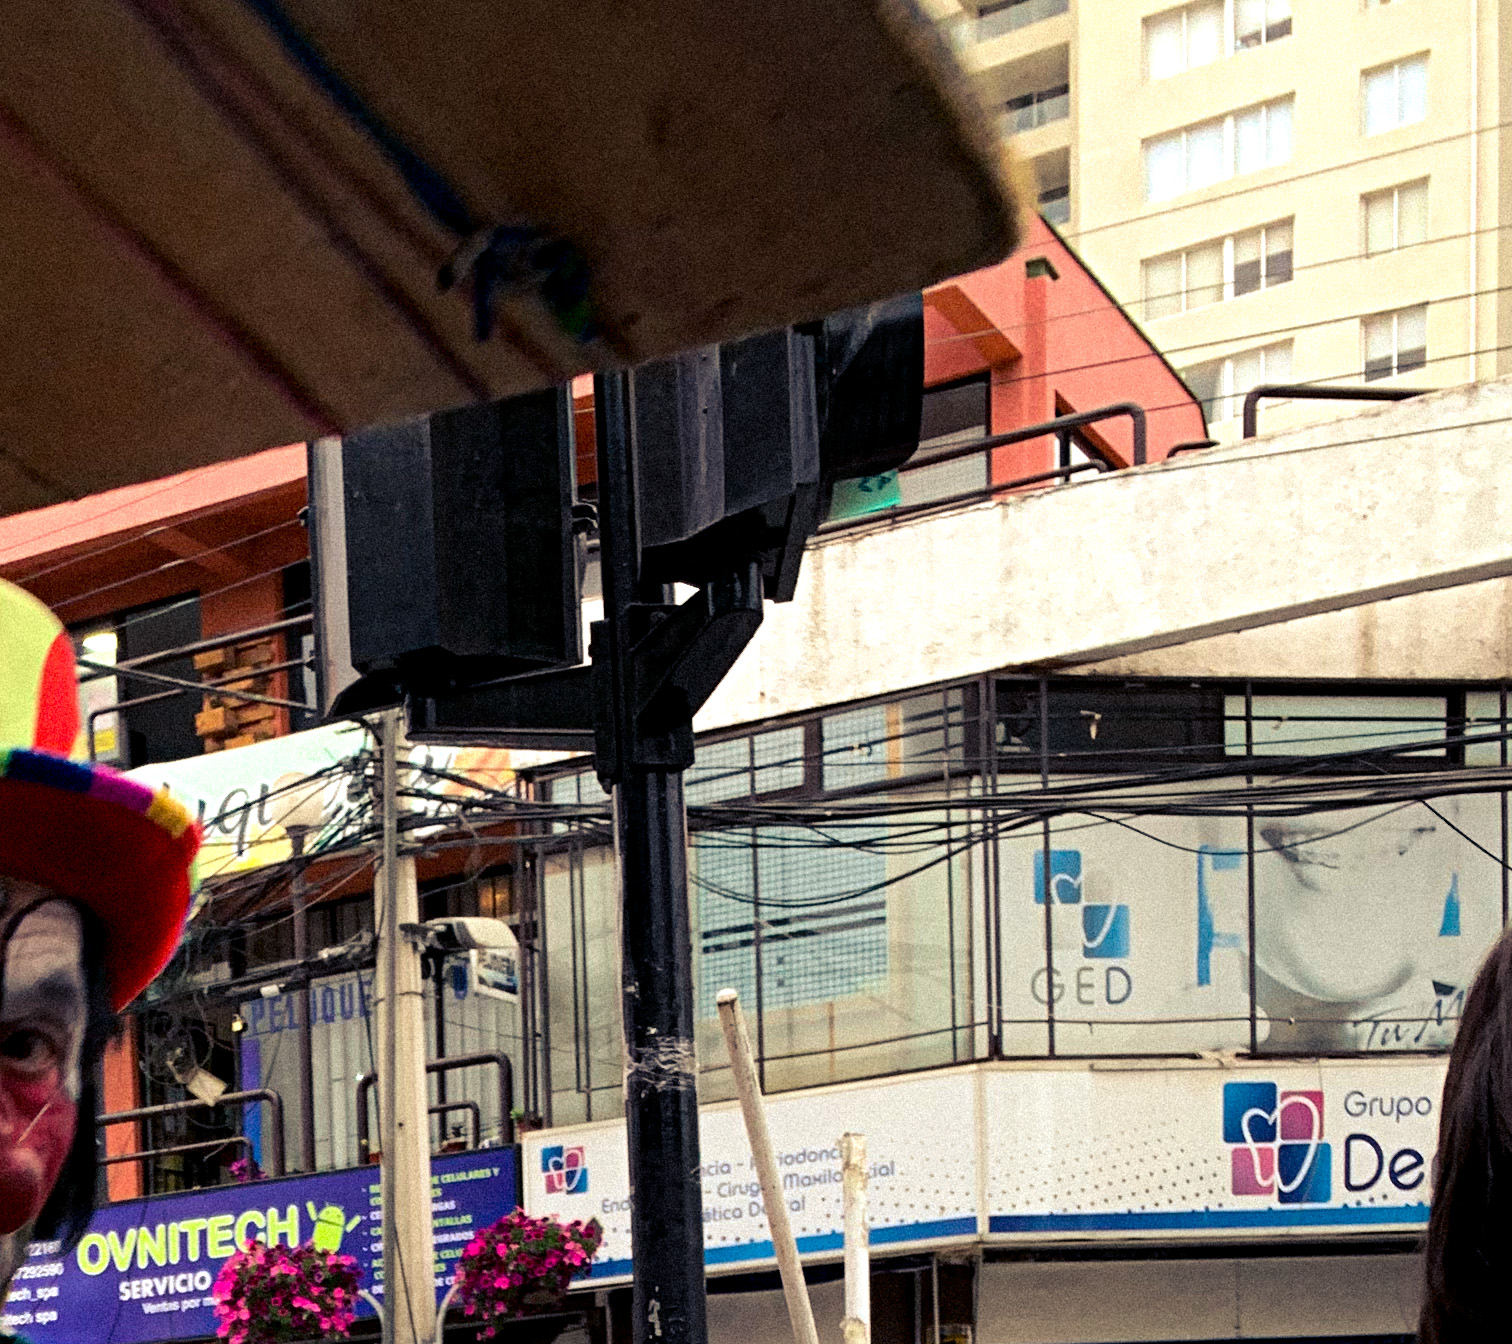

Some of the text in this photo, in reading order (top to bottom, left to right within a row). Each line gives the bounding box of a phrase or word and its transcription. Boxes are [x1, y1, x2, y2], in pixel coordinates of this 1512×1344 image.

[1031, 966, 1133, 1005] GED
[1344, 1091, 1433, 1123] Grupo
[1344, 1133, 1426, 1192] De
[77, 1206, 300, 1276] OVNITECH
[119, 1270, 212, 1301] SERVICIO
